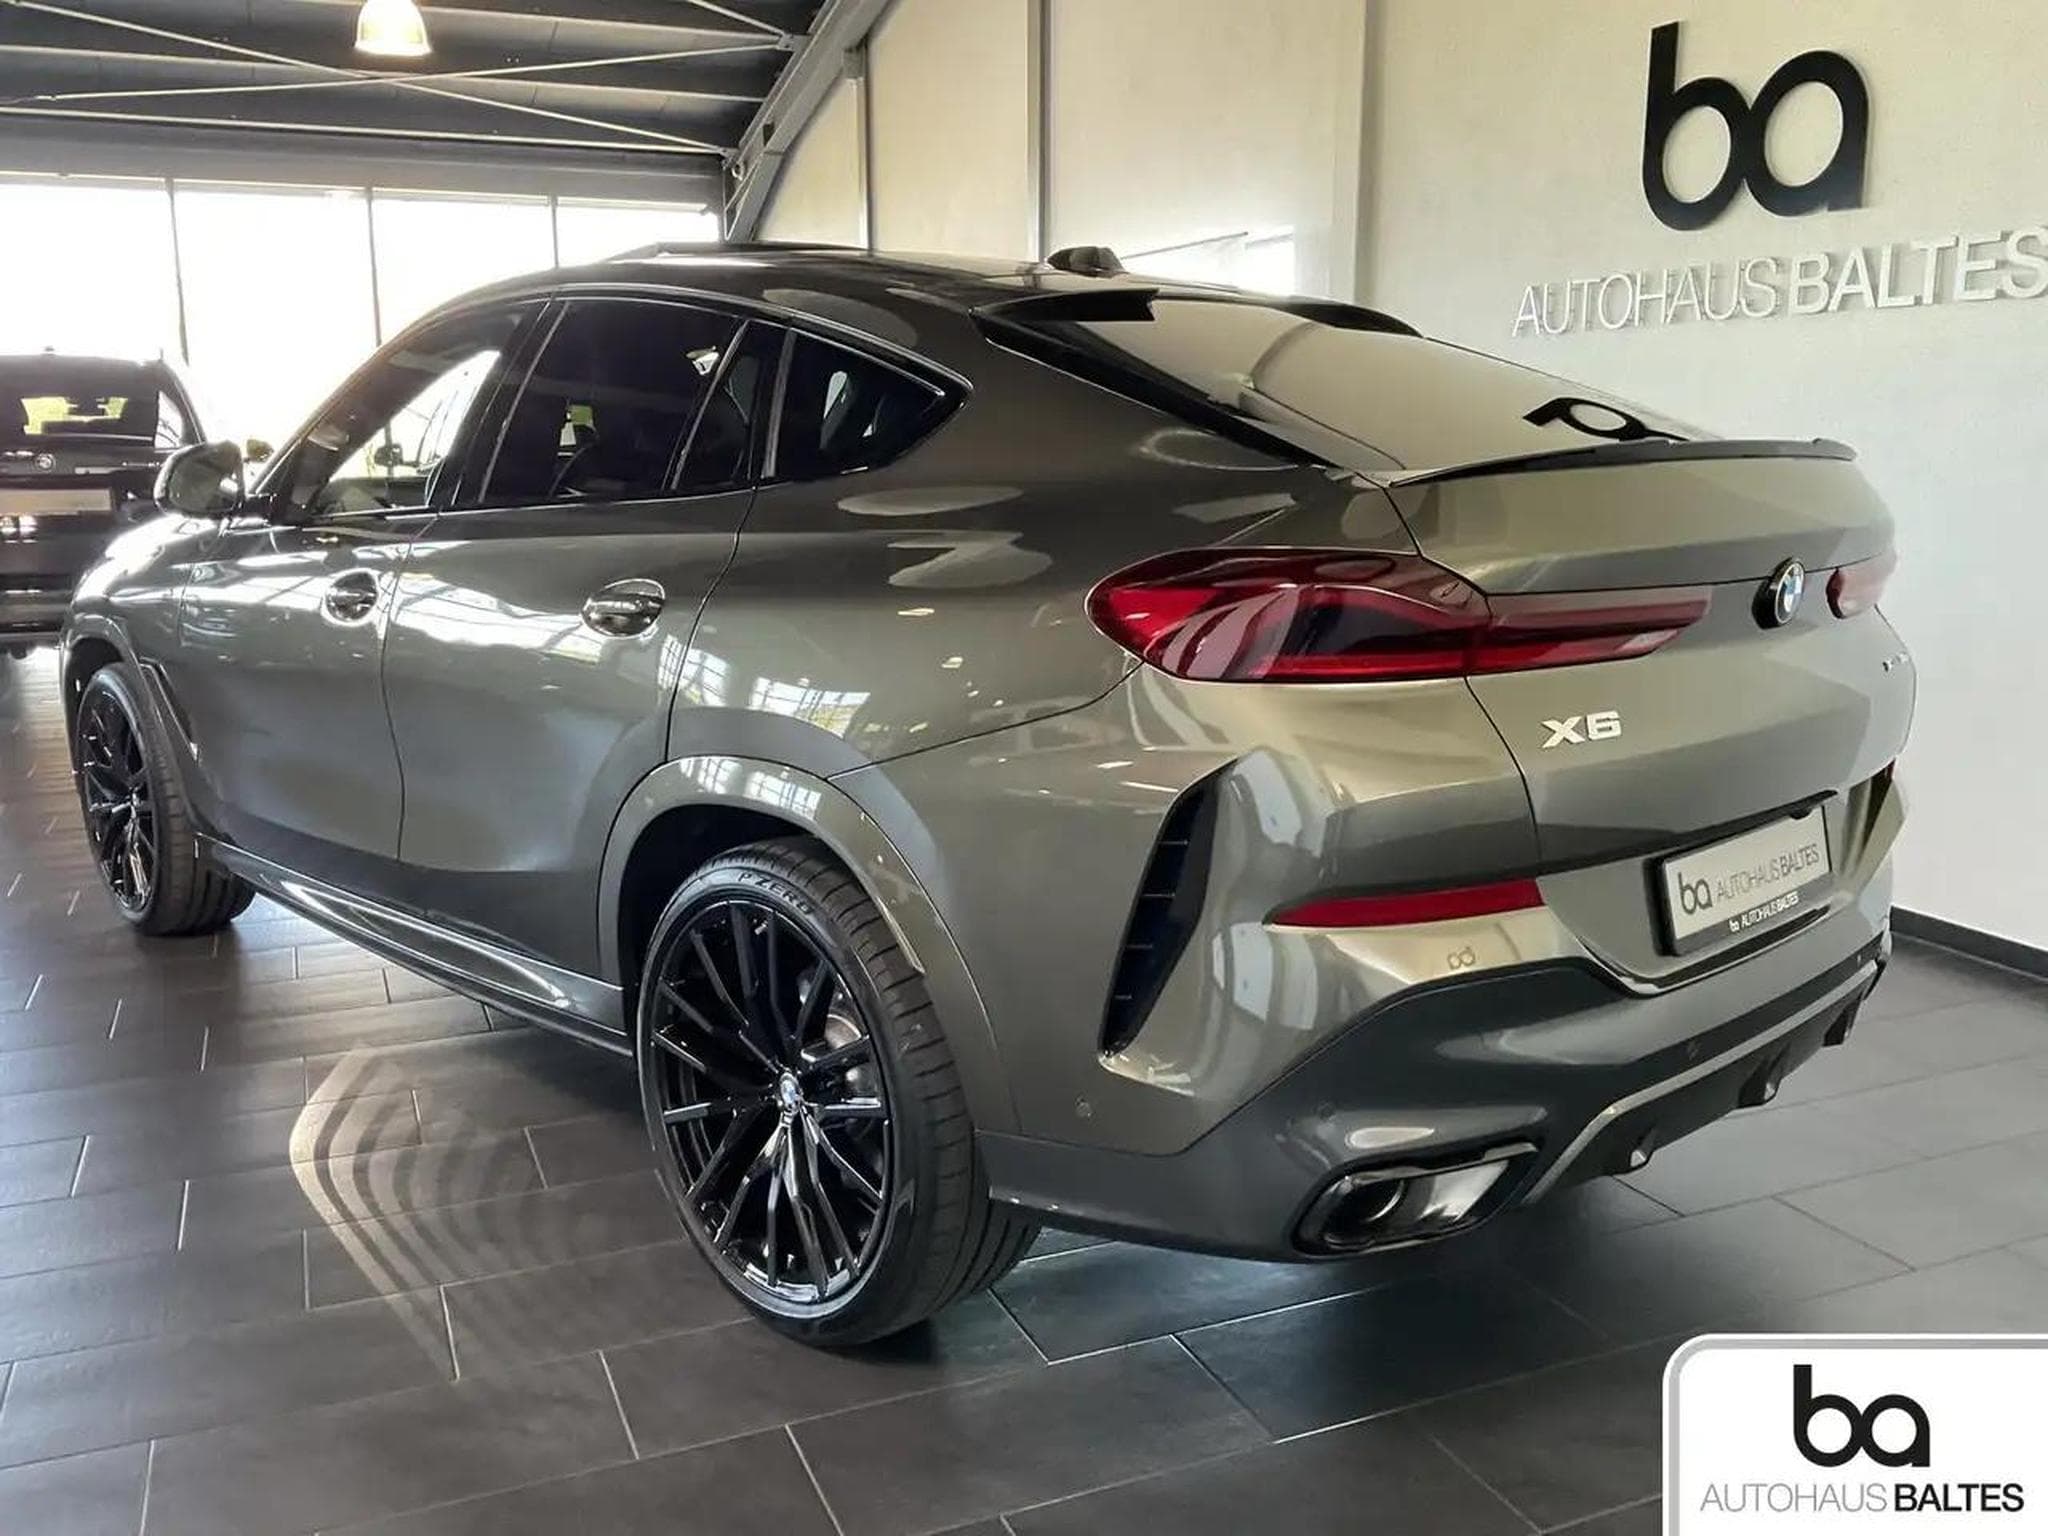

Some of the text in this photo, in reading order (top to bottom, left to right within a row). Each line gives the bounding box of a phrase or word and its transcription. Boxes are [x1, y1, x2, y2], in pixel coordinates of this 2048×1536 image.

[1643, 20, 1869, 231] ba
[1512, 225, 2048, 337] AUTOHAUS BALTES
[1541, 710, 1622, 749] X6
[1678, 872, 1712, 915] ba
